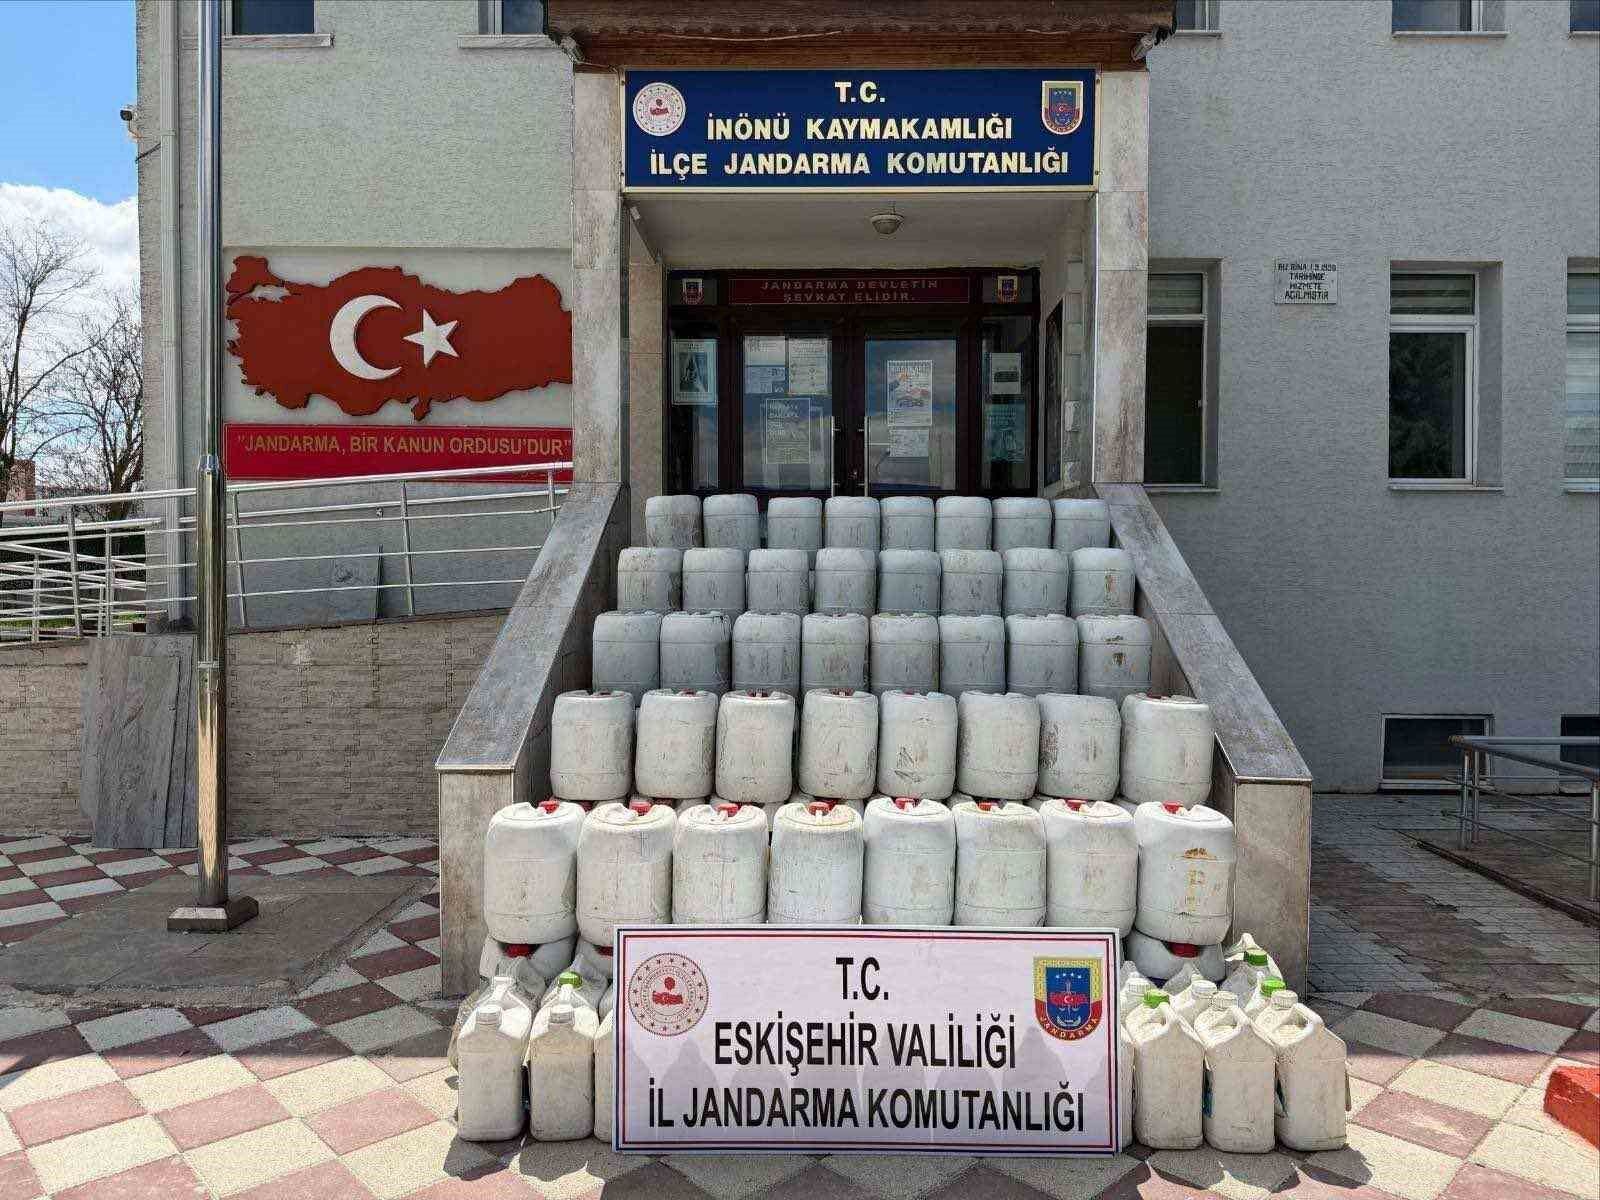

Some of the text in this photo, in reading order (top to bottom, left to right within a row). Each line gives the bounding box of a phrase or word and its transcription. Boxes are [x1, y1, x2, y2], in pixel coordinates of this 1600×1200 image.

[834, 81, 886, 103] T.C.
[707, 112, 790, 141] İNÖNÜ
[806, 111, 1013, 141] KAYMAKAMLIĞI
[650, 146, 1069, 181] İLÇE JANDARMA KOMUTANLIĞI
[760, 280, 849, 290] JANDARMA
[350, 432, 379, 453] BİR
[383, 436, 445, 454] KANUN
[835, 956, 889, 1001] T.C.
[714, 1010, 1017, 1076] ESKİŞEHİR VALİLİĞİ
[649, 1077, 1085, 1133] İL JANDARMA KOMUTANLIĞI
